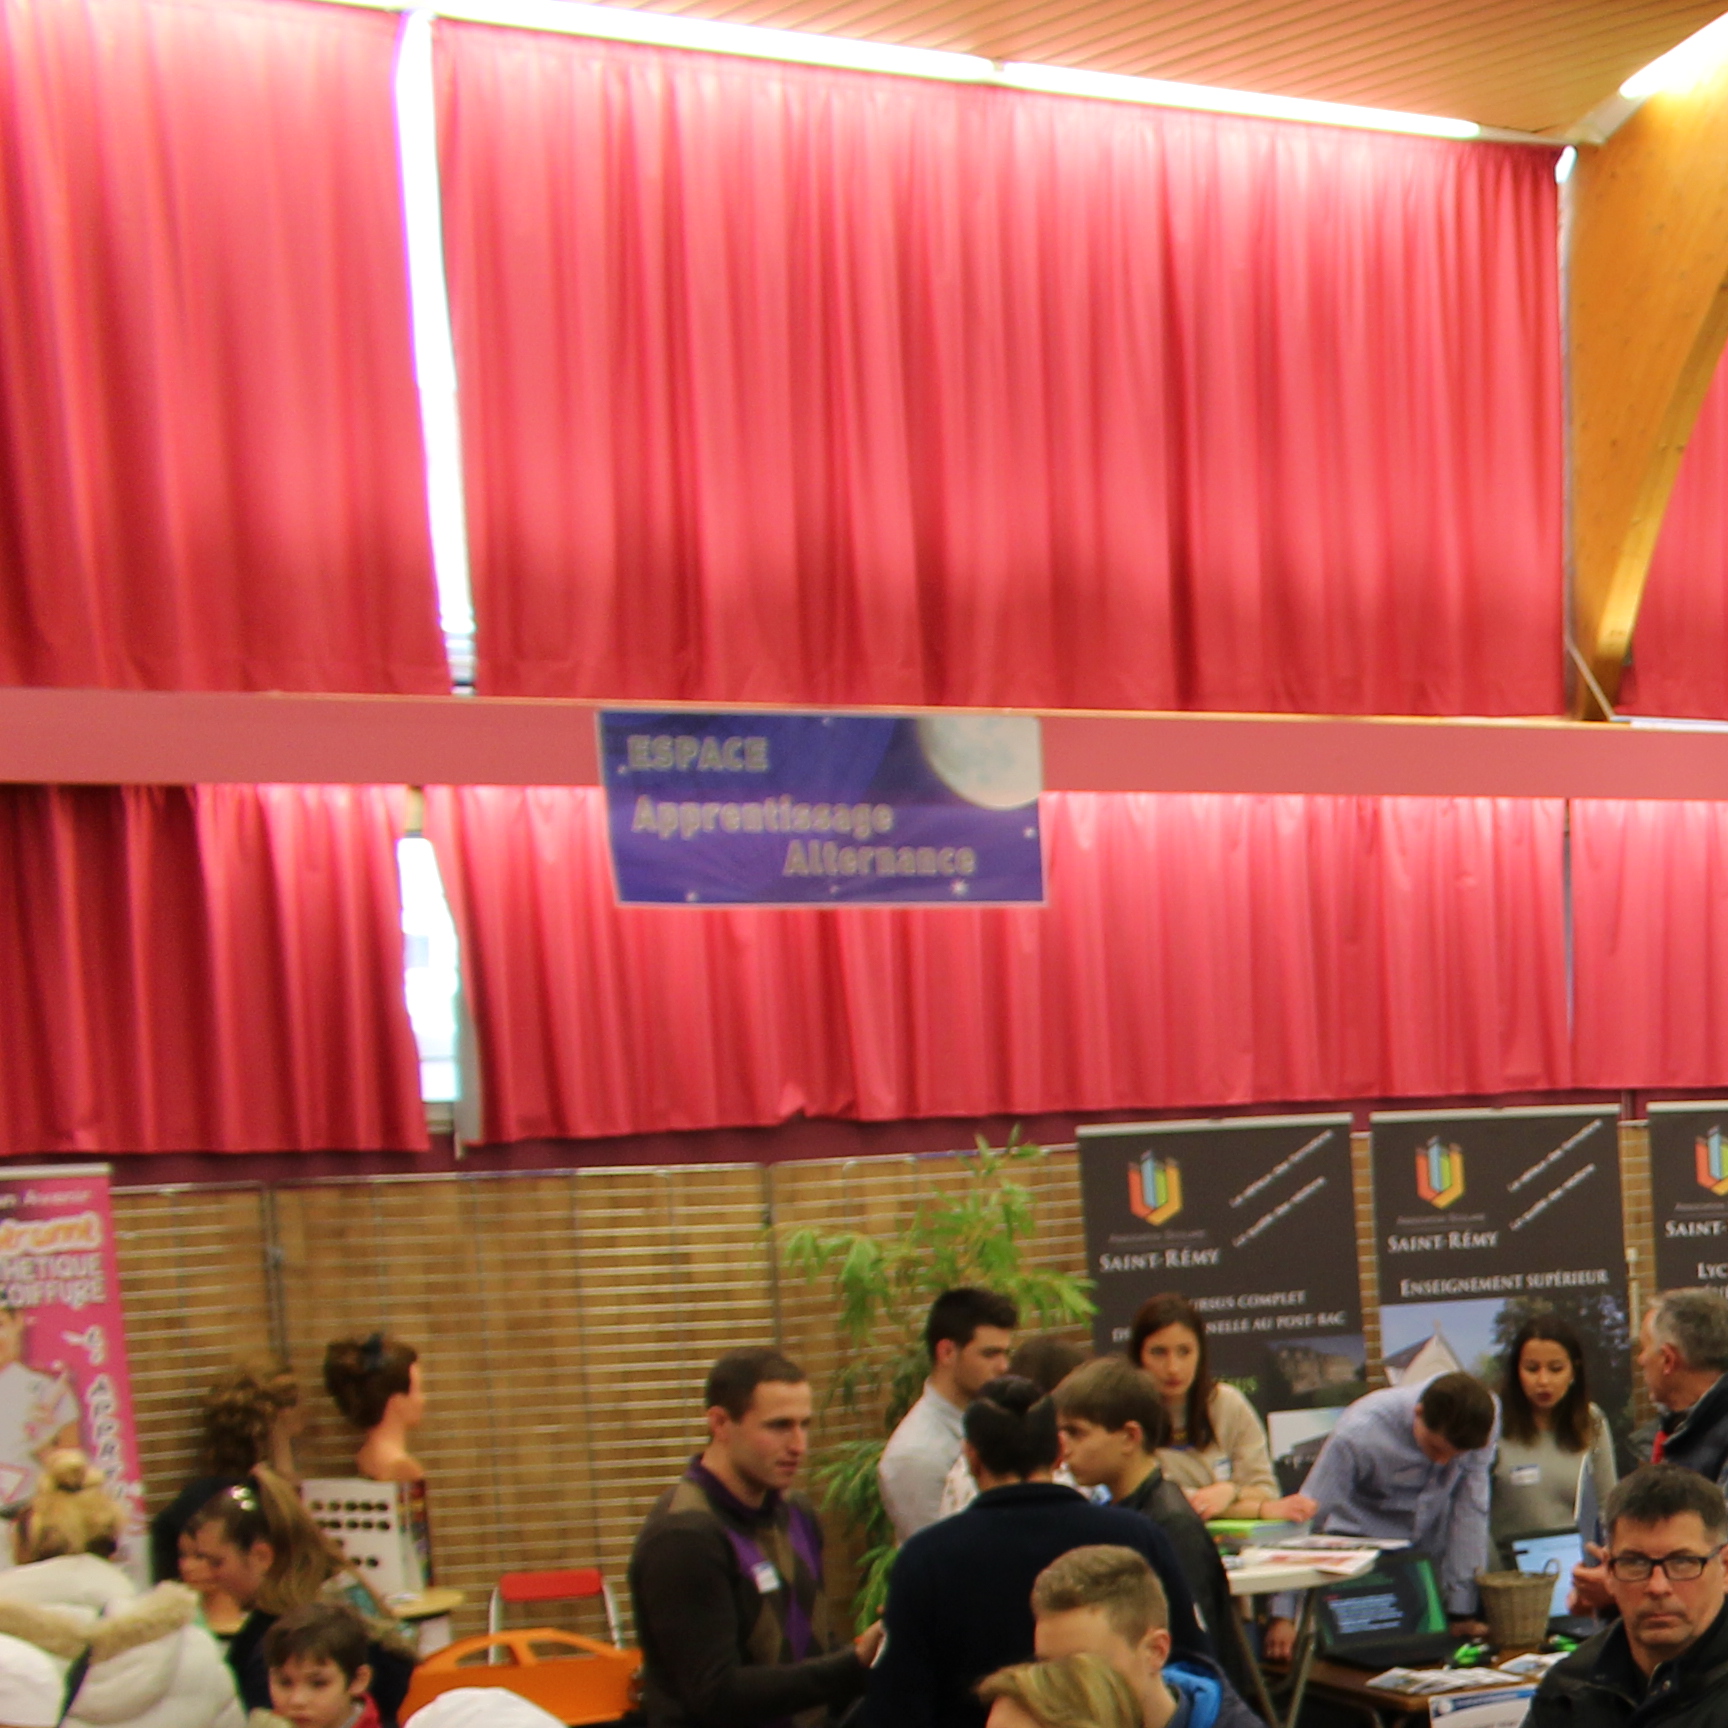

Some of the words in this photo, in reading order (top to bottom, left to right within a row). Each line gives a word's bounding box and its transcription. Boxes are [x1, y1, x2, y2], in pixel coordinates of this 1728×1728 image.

[627, 736, 769, 772] ESPACE
[631, 795, 894, 839] Apprentissage
[782, 841, 976, 879] Alternance
[1388, 1229, 1499, 1252] SAINT-RÉMY
[1401, 1274, 1523, 1297] ENSEIGNEMENT
[1526, 1268, 1610, 1289] SUPÉRIEUR
